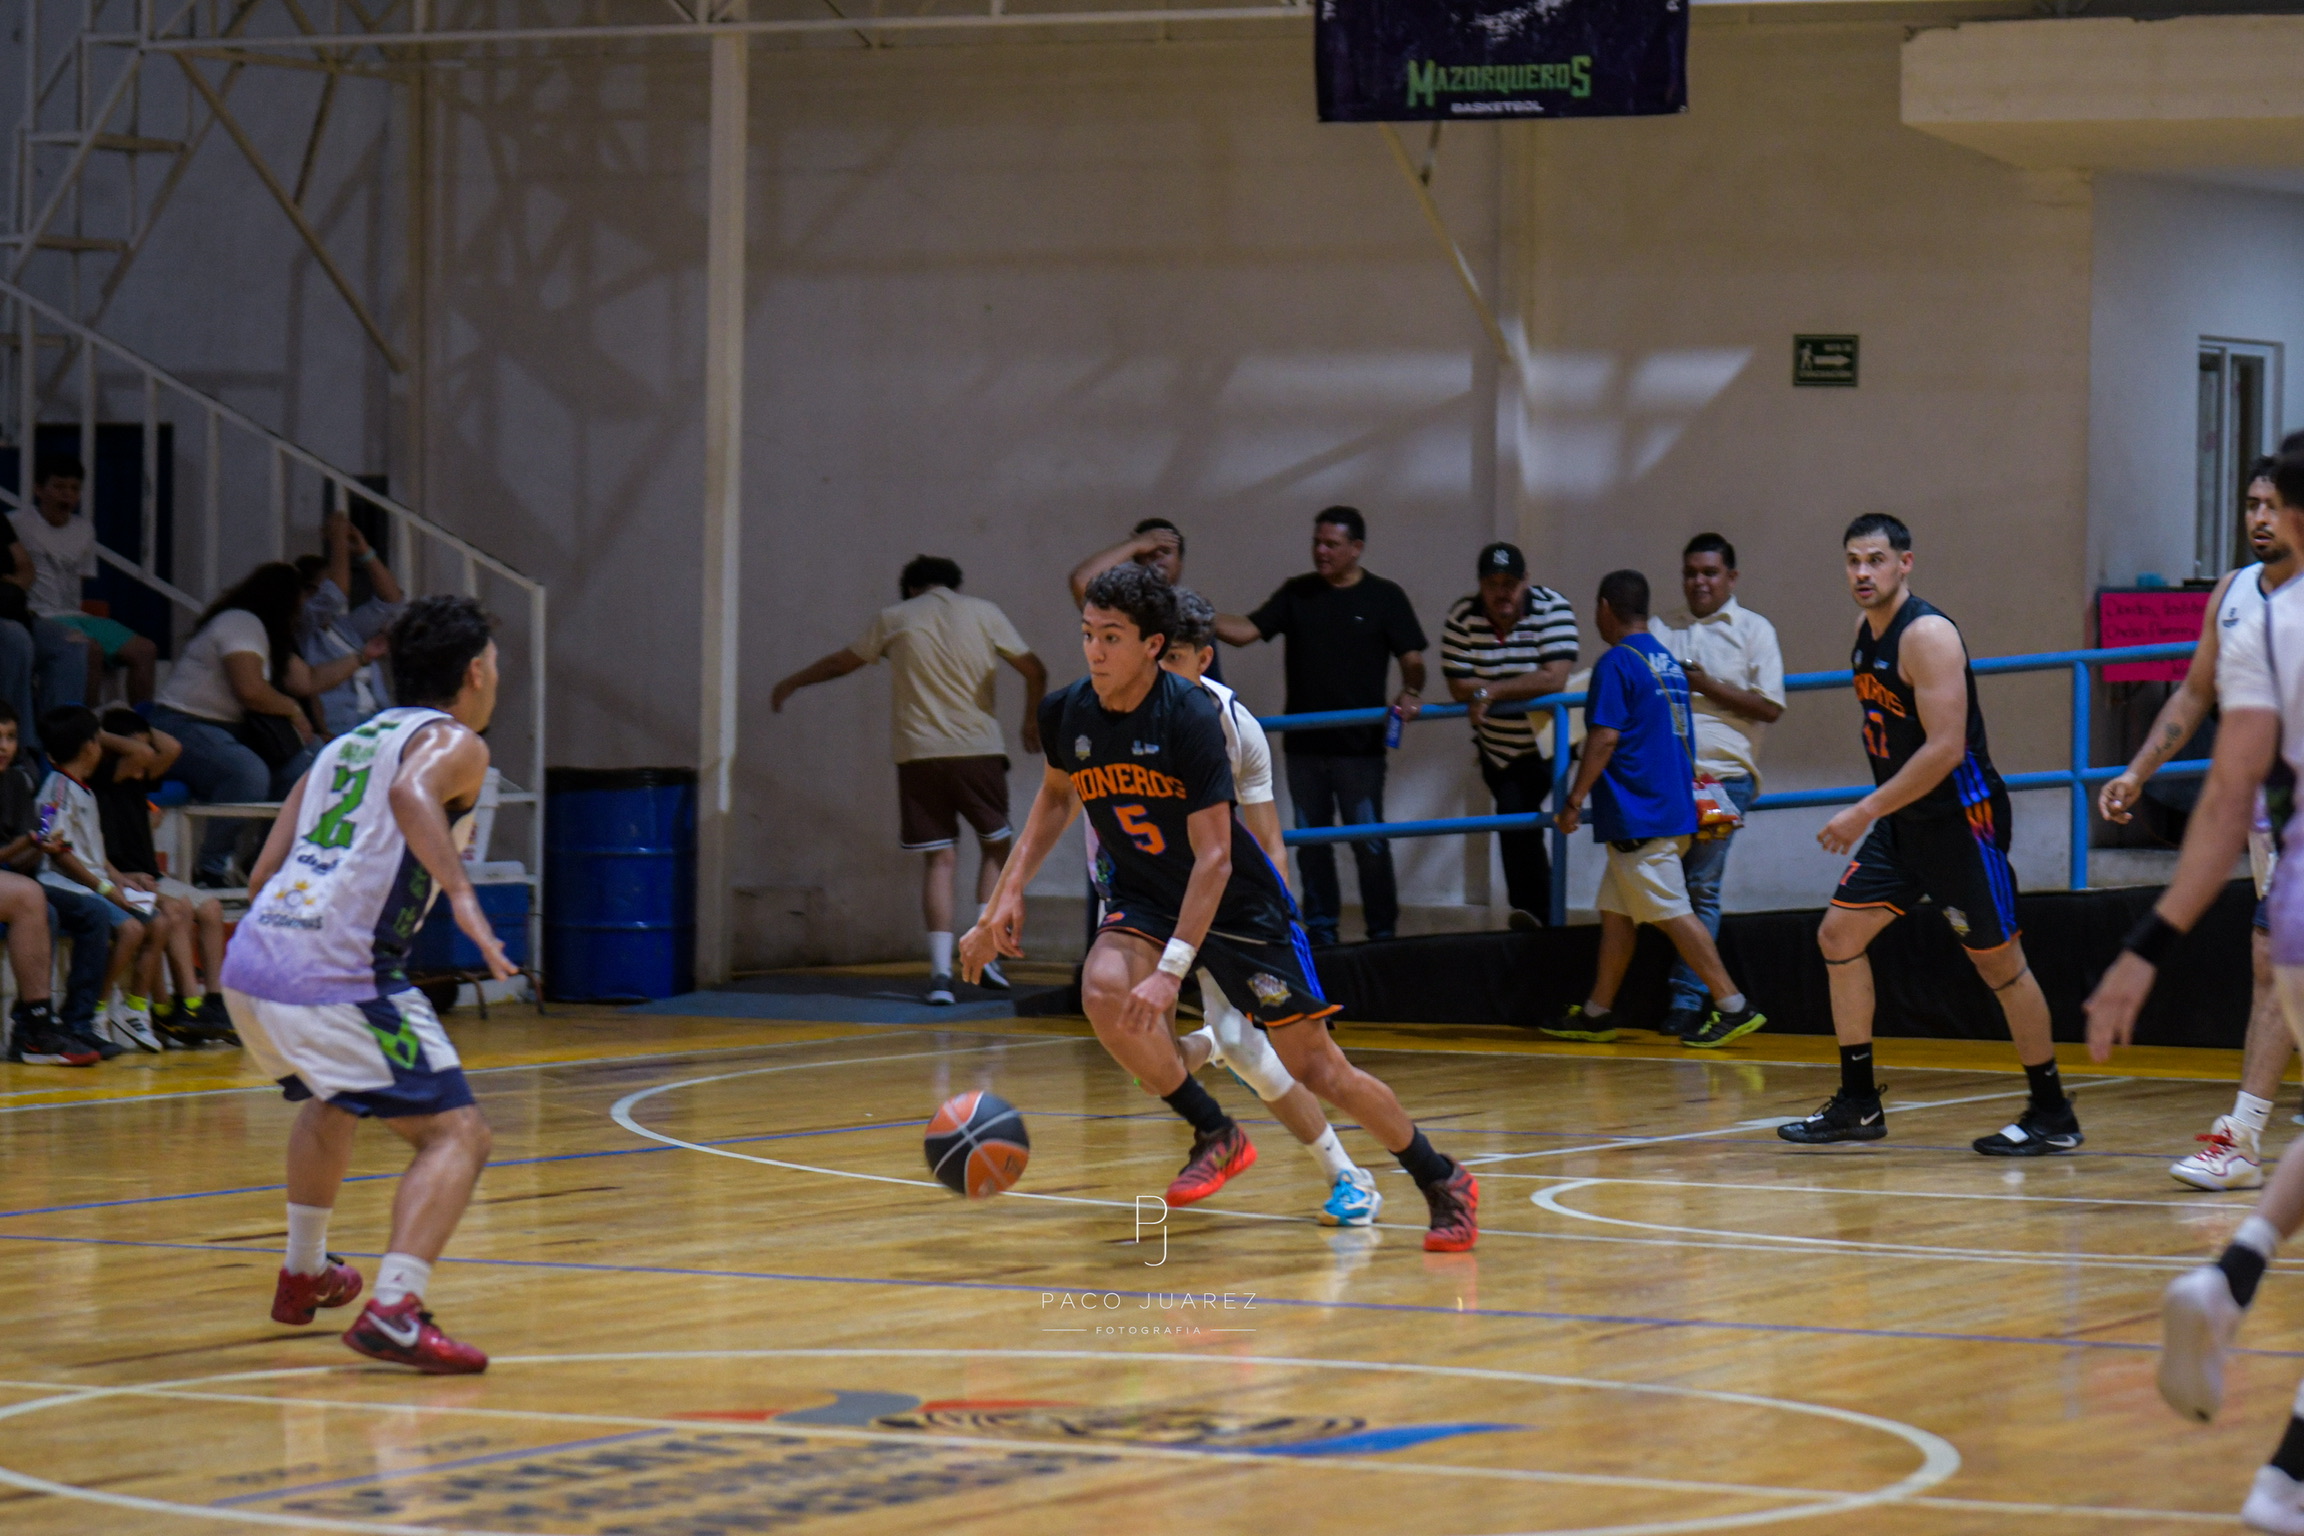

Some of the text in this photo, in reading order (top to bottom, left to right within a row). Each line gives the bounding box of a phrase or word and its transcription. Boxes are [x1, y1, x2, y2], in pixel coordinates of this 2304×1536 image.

[1407, 55, 1592, 109] MAZORQUEROS
[300, 764, 373, 850] 2
[1111, 803, 1167, 856] 5
